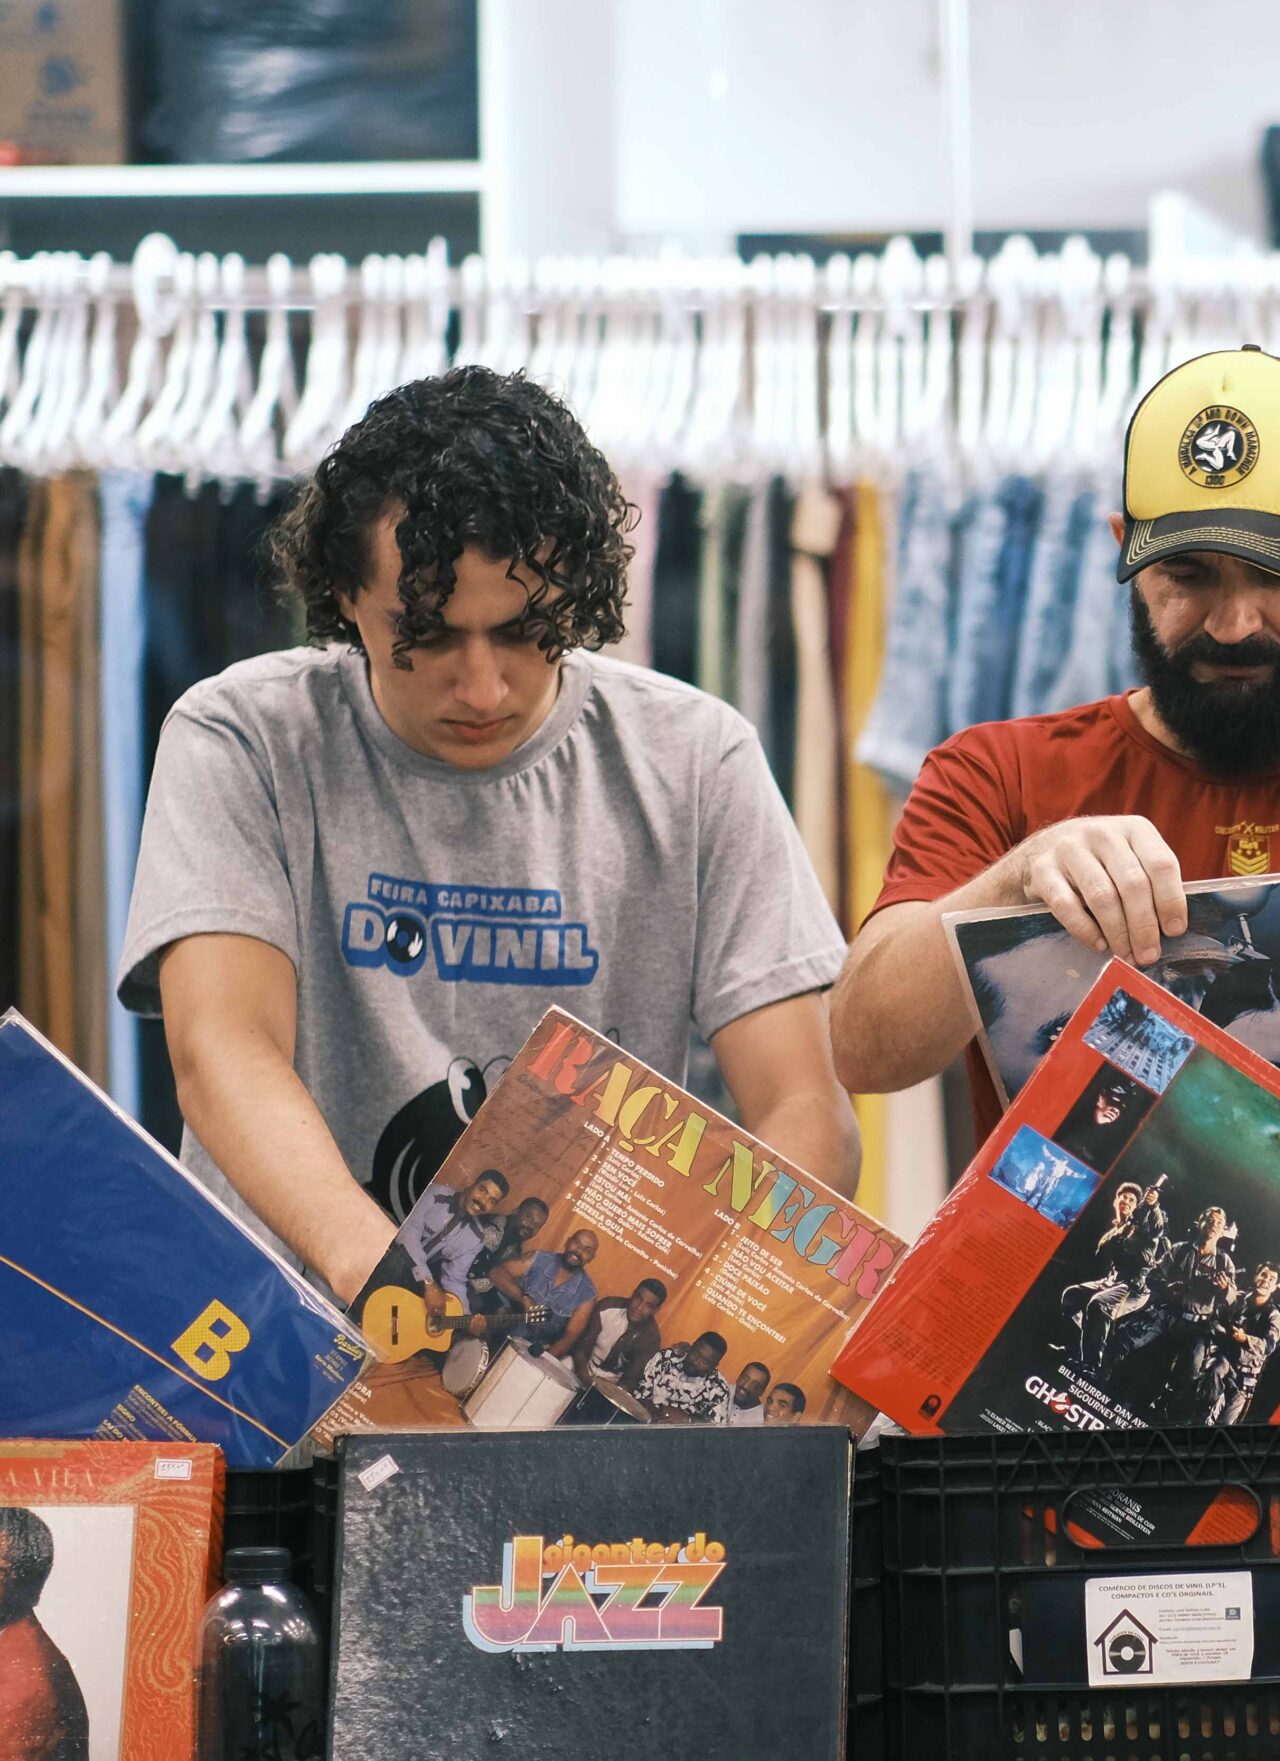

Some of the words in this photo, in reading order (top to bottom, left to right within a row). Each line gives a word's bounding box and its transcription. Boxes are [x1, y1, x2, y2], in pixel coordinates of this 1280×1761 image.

[370, 879, 428, 904] FEIRA
[438, 890, 558, 912] CAPIXABA
[437, 923, 594, 970] VINIL
[583, 1121, 604, 1138] LADO
[602, 1133, 611, 1143] A
[524, 1021, 711, 1178] RAÇA
[702, 1138, 901, 1301] NEGR
[601, 1161, 618, 1175] SEM
[609, 1148, 634, 1168] TEMPO
[634, 1164, 664, 1187] PERDIDO
[593, 1174, 616, 1192] ESTOU
[615, 1189, 632, 1203] MAL
[575, 1199, 605, 1222] ESTRELA
[604, 1218, 624, 1234] GUIA
[584, 1186, 602, 1202] NÃO
[601, 1197, 628, 1218] QUERO
[626, 1214, 646, 1230] MAIS
[645, 1226, 672, 1248] SOFRER
[714, 1209, 734, 1225] LADO
[739, 1235, 759, 1251] JEITO
[759, 1248, 769, 1258] DE
[768, 1254, 783, 1267] SER
[722, 1261, 742, 1277] DOCE
[741, 1273, 770, 1295] PAIXÃO
[731, 1248, 748, 1263] NÃO
[748, 1259, 766, 1274] VOU
[765, 1270, 795, 1293] ACEITAR
[705, 1286, 738, 1311] QUANDO
[737, 1308, 746, 1317] TE
[736, 1288, 747, 1299] DE
[170, 1298, 251, 1383] B
[116, 1404, 135, 1422] SIGNO
[133, 1384, 168, 1416] ENCONTREI
[166, 1413, 174, 1421] A
[172, 1419, 197, 1442] FÓRMUL
[1058, 1365, 1076, 1381] BILL
[1075, 1378, 1110, 1405] MURRAY
[1113, 1404, 1132, 1420] DAN
[1131, 1416, 1148, 1431] AYK
[1067, 1384, 1115, 1419] SIGOURNEY
[1114, 1416, 1132, 1431] WEA
[1110, 1488, 1142, 1512] ORANIS
[1124, 1507, 1137, 1518] JOHN
[685, 1532, 726, 1562] do
[472, 1536, 726, 1644] JAZZ
[1099, 1584, 1135, 1592] COMÉRCIO
